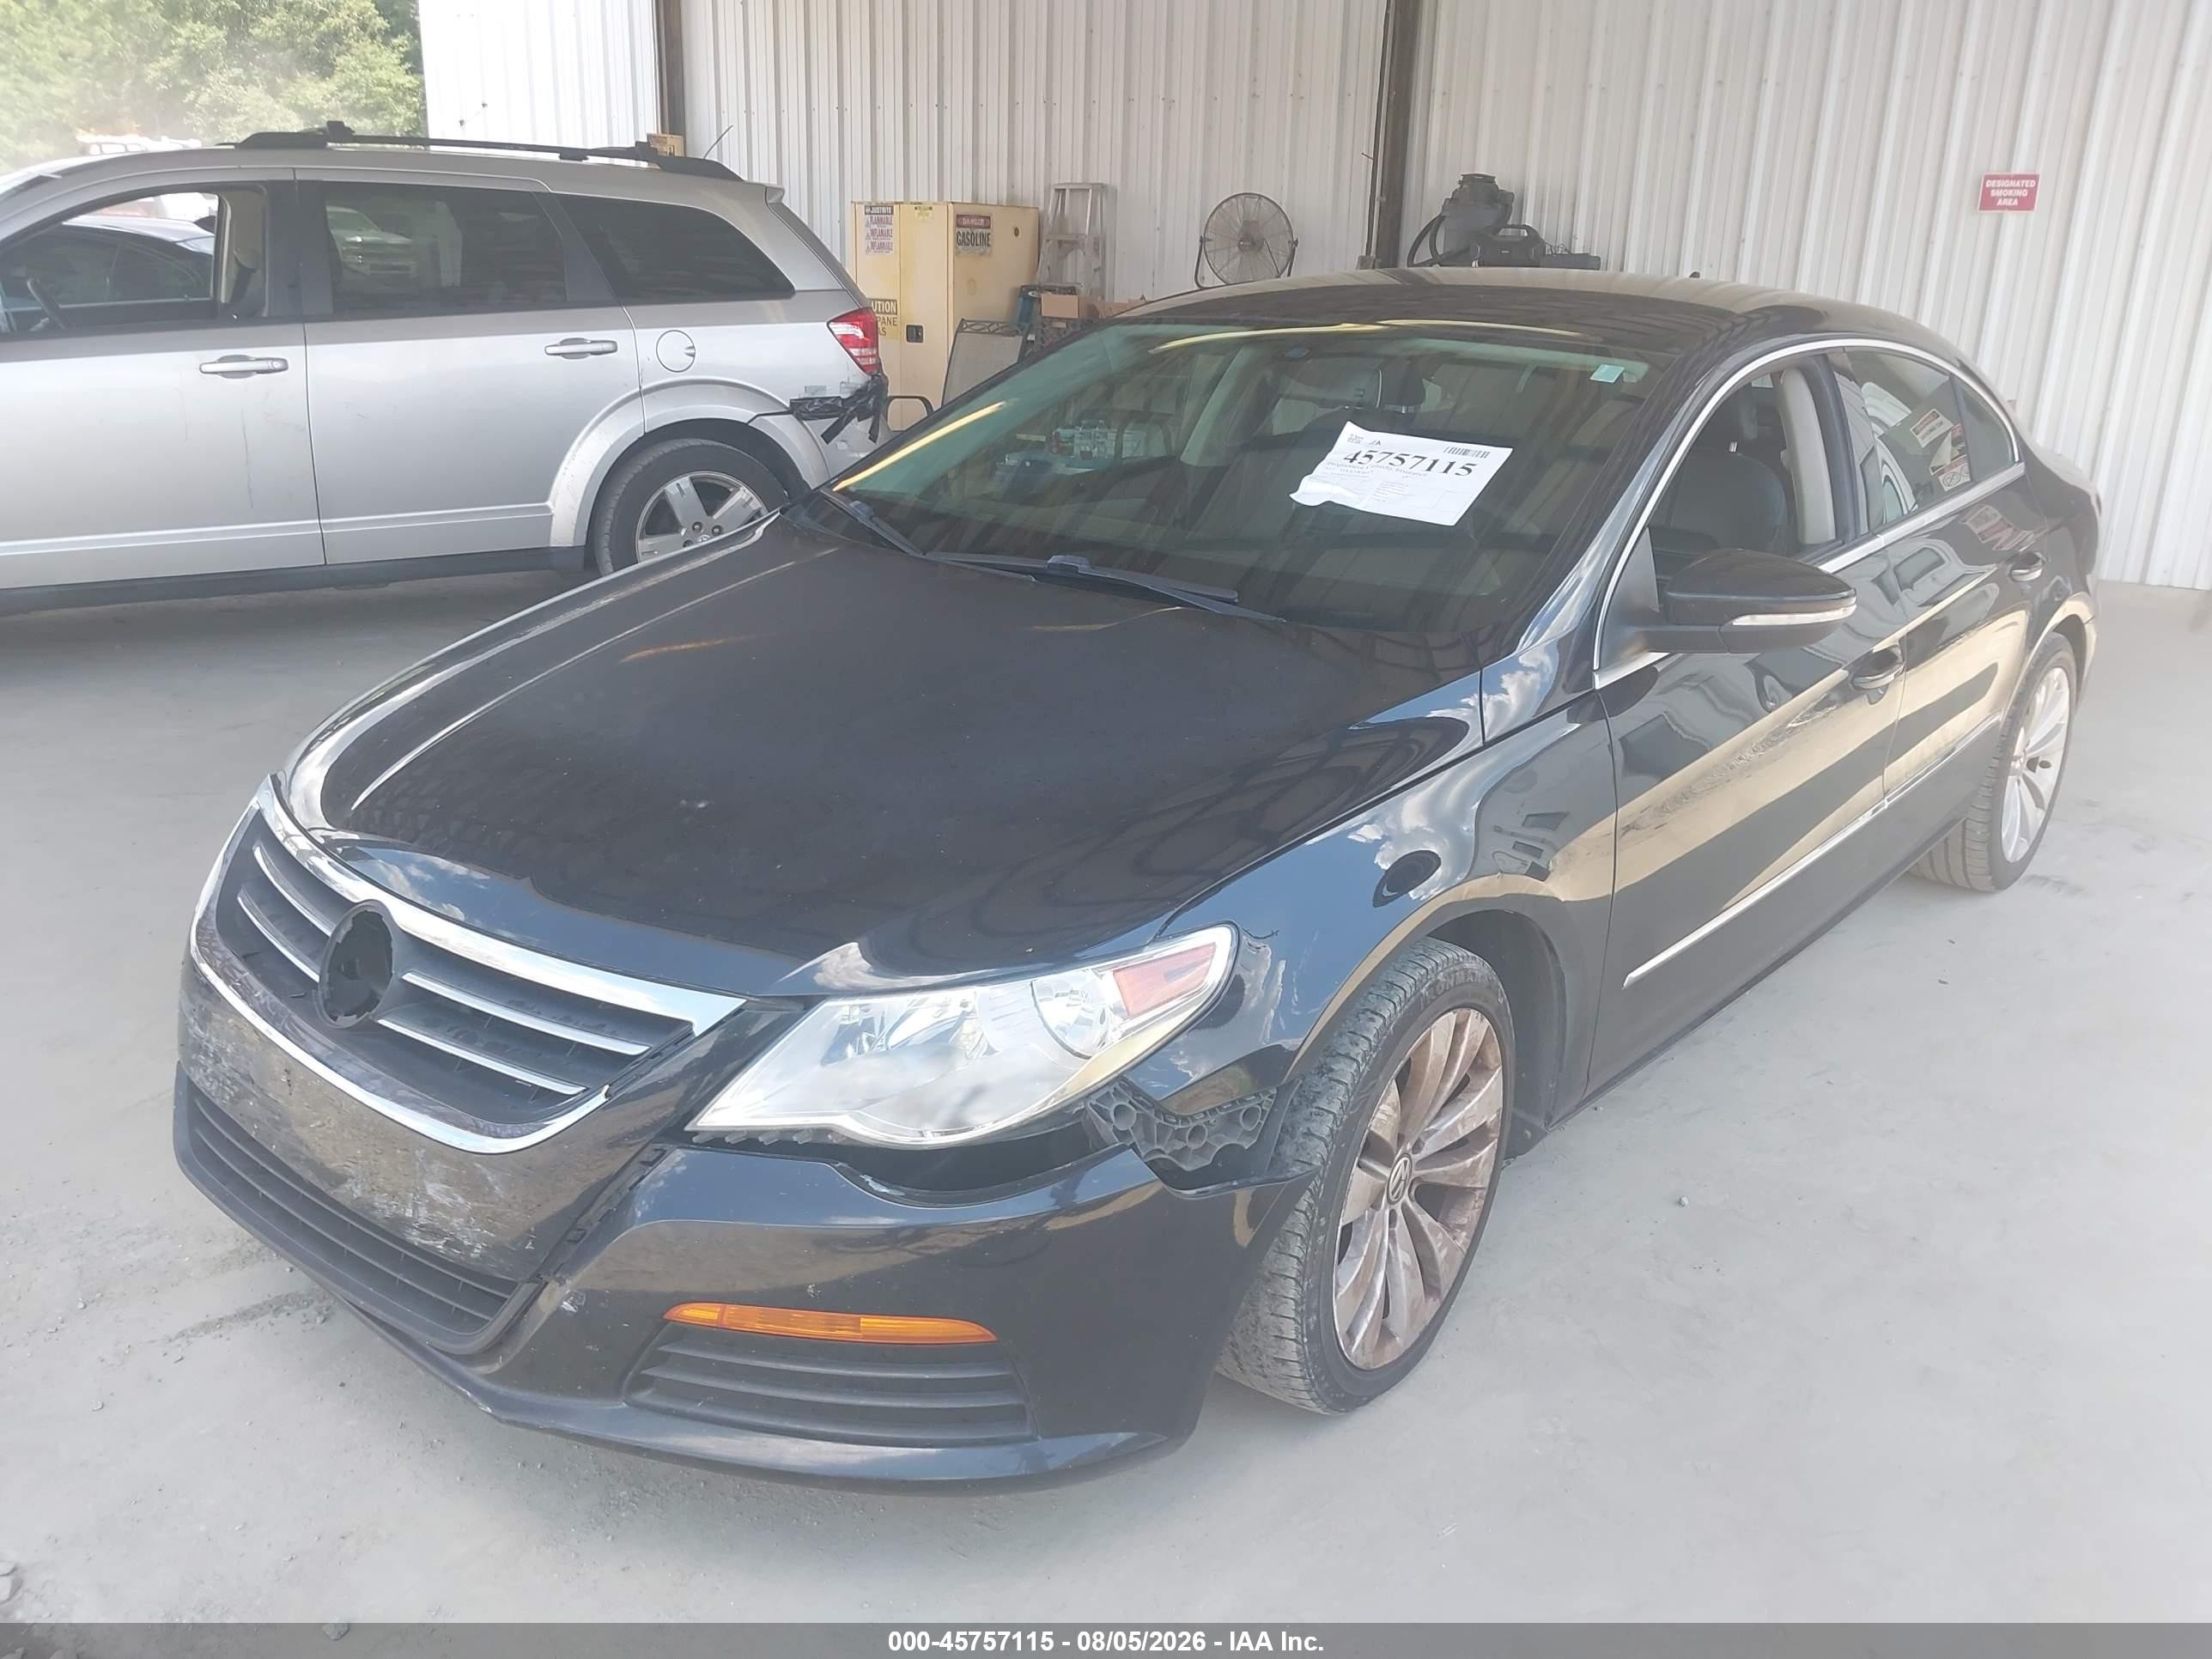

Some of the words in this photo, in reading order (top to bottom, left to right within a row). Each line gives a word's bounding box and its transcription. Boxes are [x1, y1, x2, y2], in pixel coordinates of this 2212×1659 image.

[956, 231, 991, 246] GASOLINE
[872, 301, 896, 313] UTION
[1343, 449, 1478, 477] 45757115
